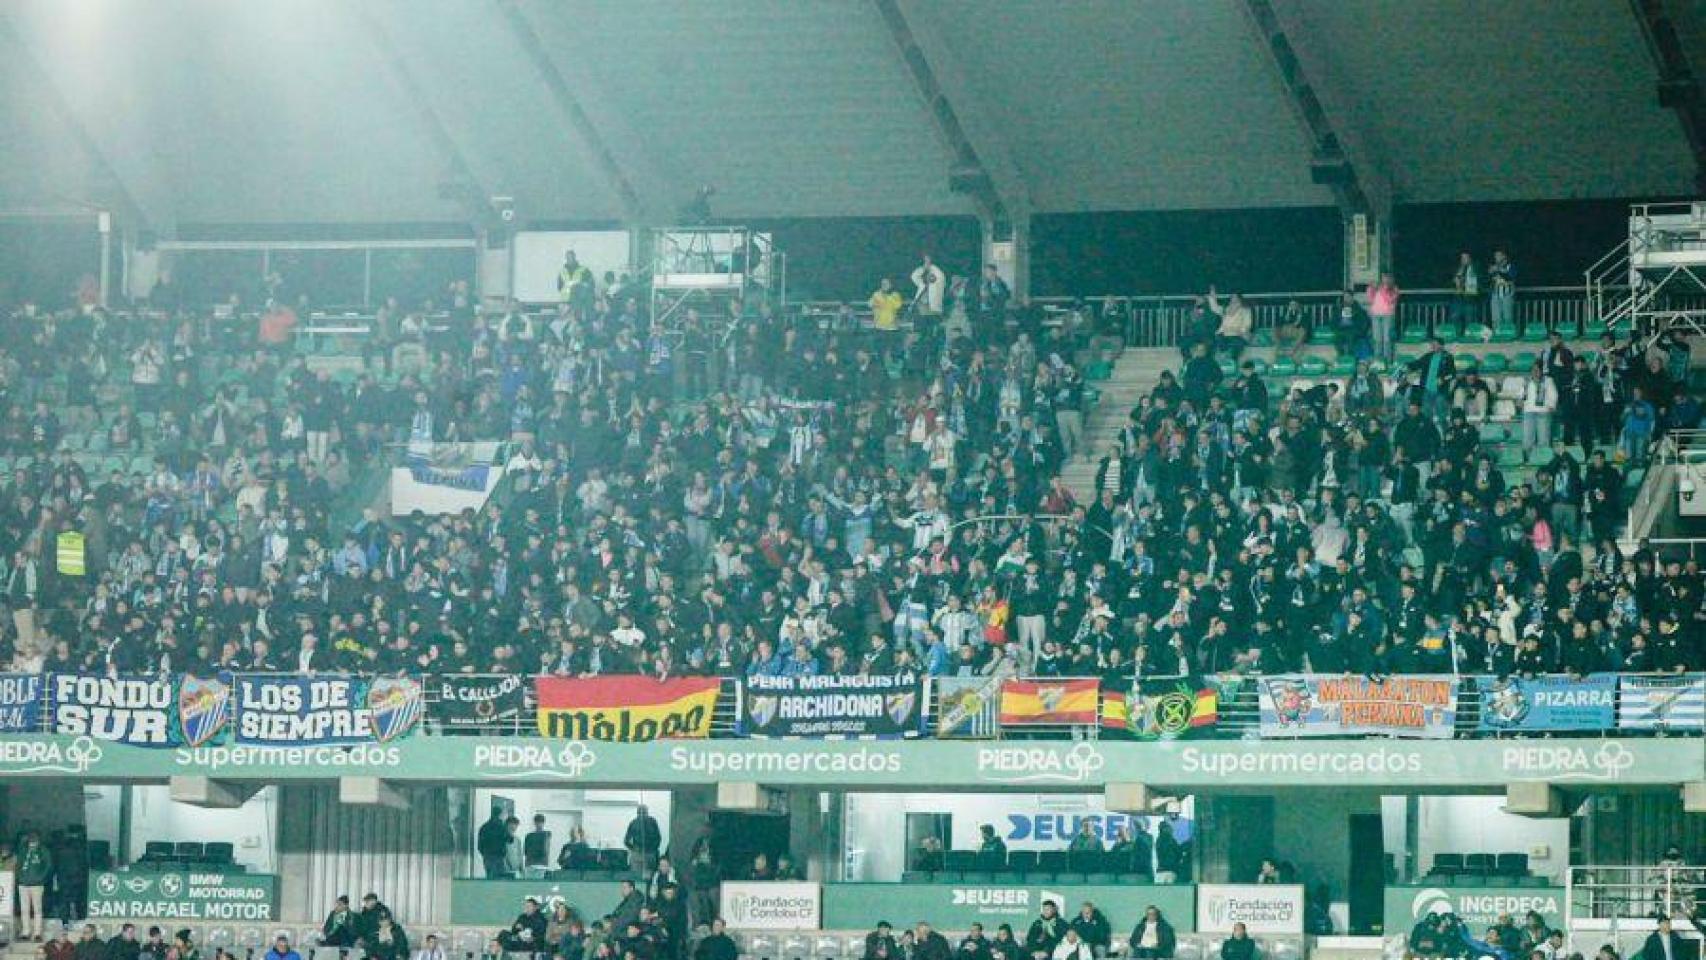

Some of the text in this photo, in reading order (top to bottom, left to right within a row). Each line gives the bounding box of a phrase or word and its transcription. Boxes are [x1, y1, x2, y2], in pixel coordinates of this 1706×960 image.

[56, 675, 171, 708] FONDO
[242, 681, 349, 711] LOS DE
[1534, 690, 1613, 707] PIZARRA
[780, 693, 883, 717] ARCHIDONA
[56, 705, 167, 743] SUR
[241, 710, 374, 741] SIEMPRE
[175, 748, 400, 769] Supermercados
[475, 745, 555, 767] PIEDRA
[670, 746, 902, 775] Supermercados
[978, 748, 1061, 771] PIEDRA
[1182, 747, 1423, 777] Supermercados
[1503, 748, 1591, 771] PIEDRA
[189, 874, 223, 884] BMW
[189, 889, 264, 898] MOTORRAD
[952, 889, 1029, 905] DEUSER
[1460, 896, 1557, 914] INGEDECA
[89, 902, 271, 919] SAN RAFAEL MOTOR
